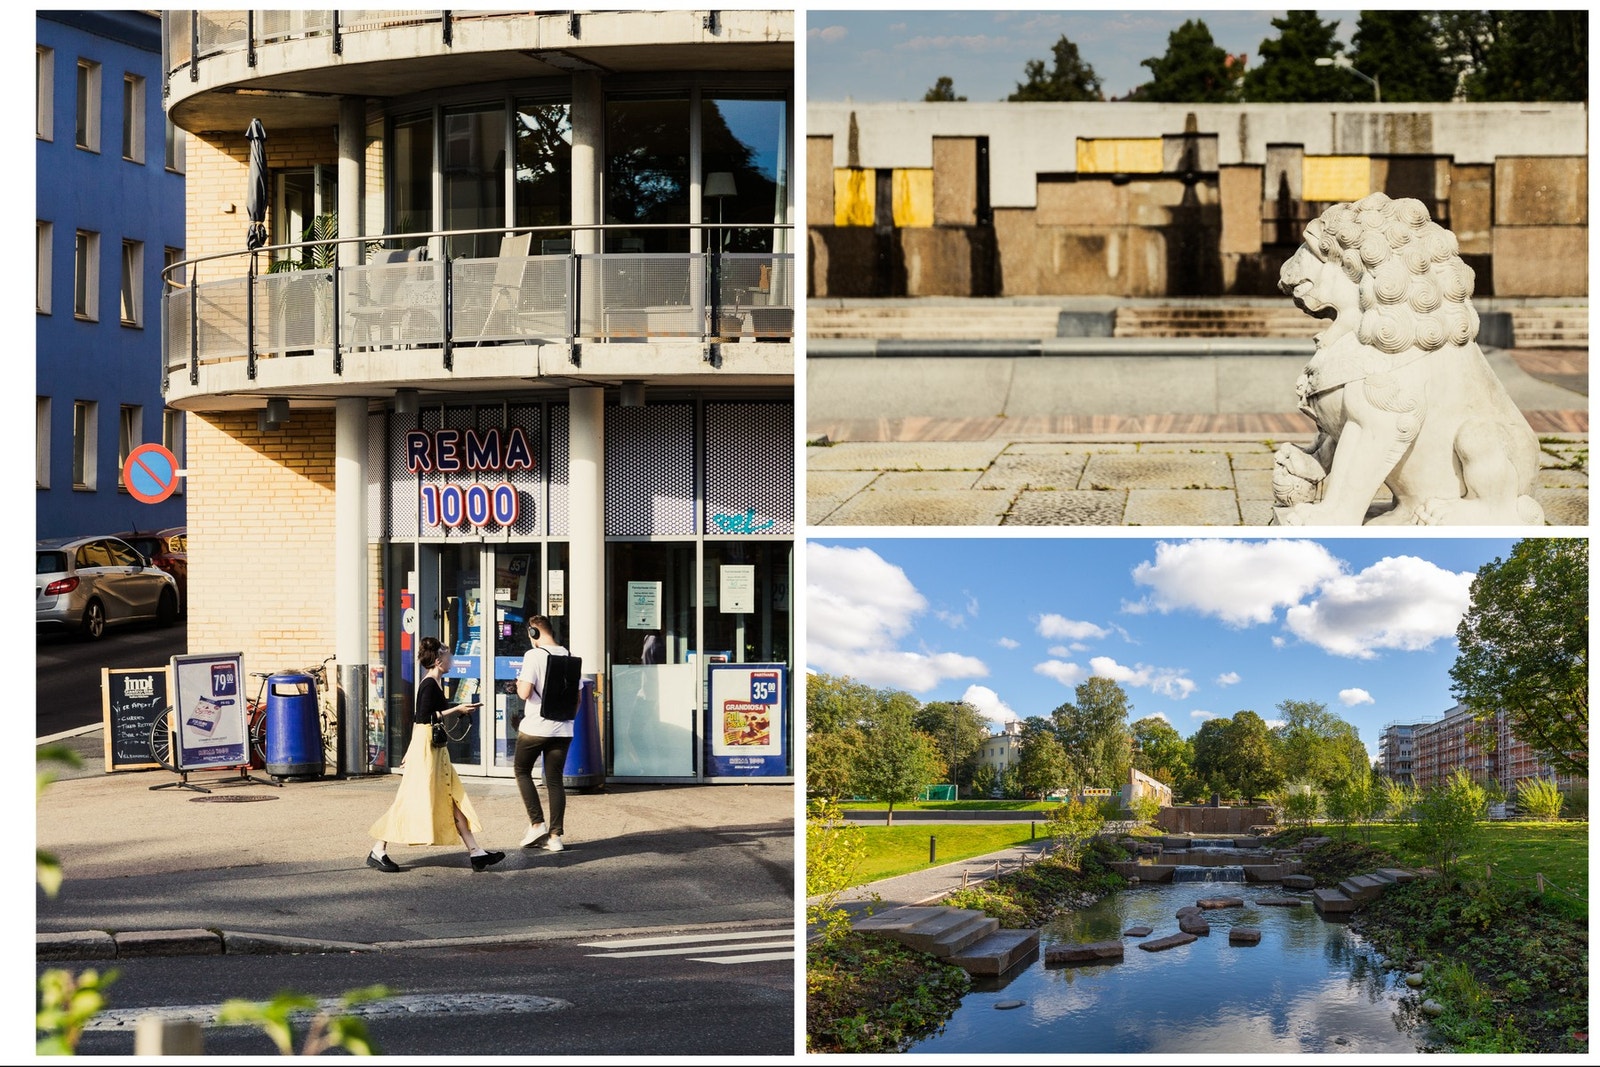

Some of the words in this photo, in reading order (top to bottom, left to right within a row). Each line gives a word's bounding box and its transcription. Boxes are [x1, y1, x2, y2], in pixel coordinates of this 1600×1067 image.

[406, 427, 535, 473] REMA
[420, 481, 520, 528] 1000
[213, 673, 227, 692] 79
[753, 682, 768, 700] 35
